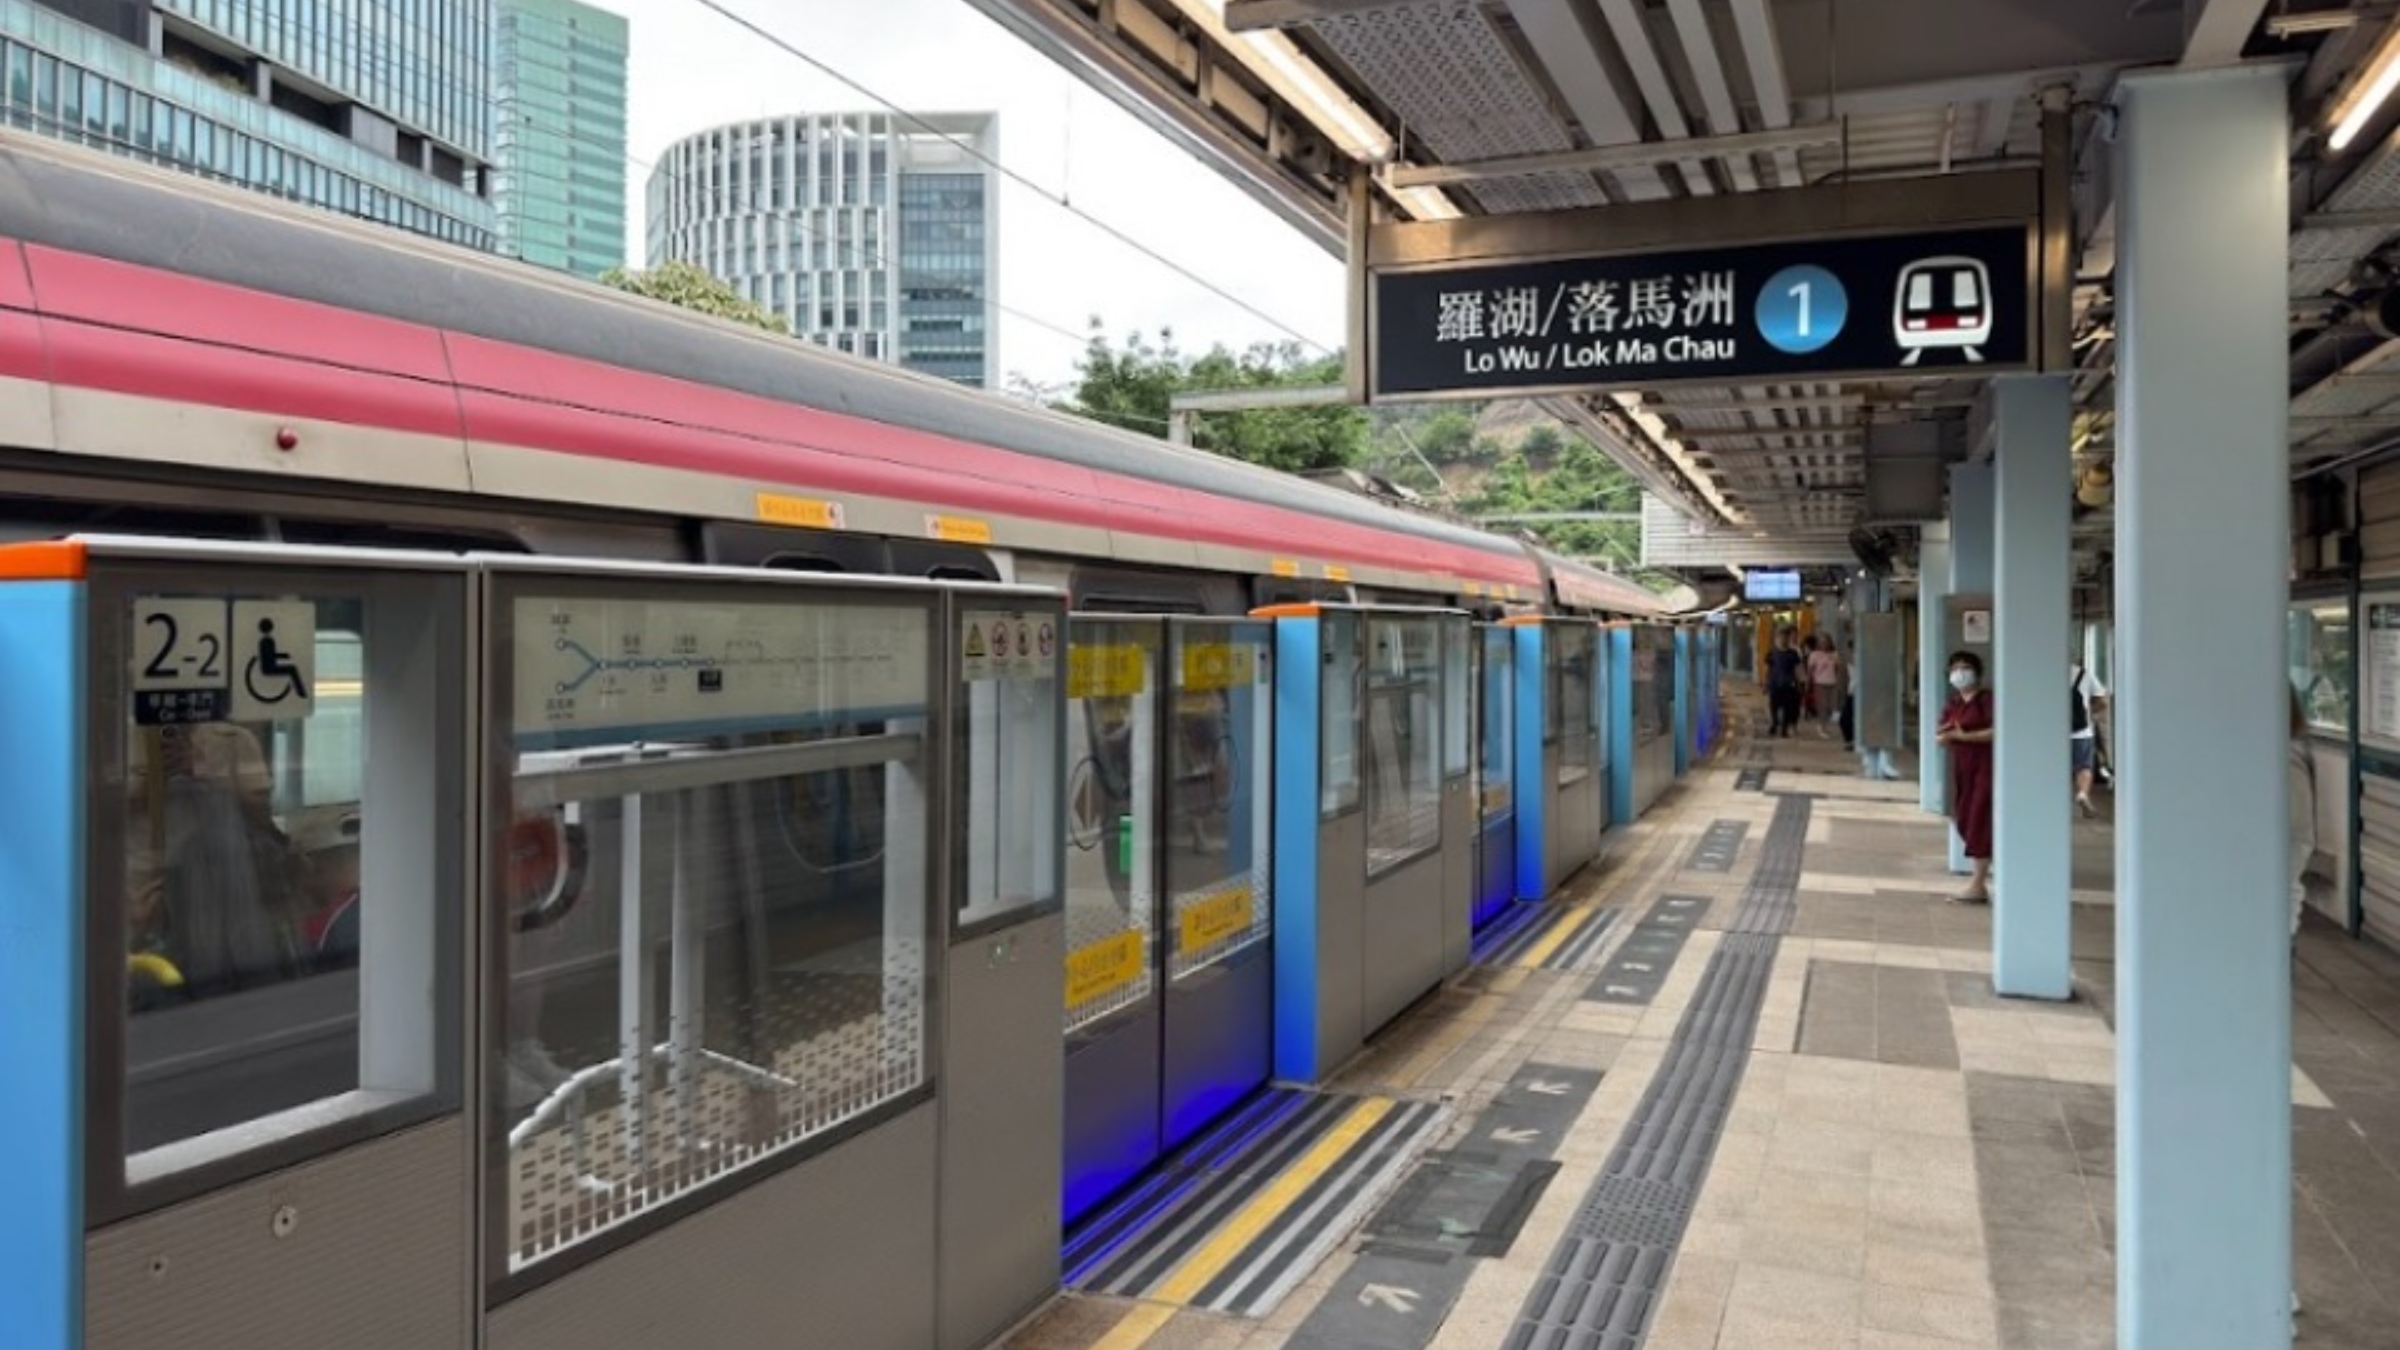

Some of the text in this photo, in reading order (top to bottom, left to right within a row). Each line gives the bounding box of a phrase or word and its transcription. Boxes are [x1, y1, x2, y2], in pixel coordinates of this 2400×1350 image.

[1436, 271, 1735, 341] 羅湖/落馬洲
[1786, 281, 1813, 338] 1
[1464, 334, 1736, 373] Lo Wu / Lok Ma Chau
[144, 613, 220, 677] 2-2
